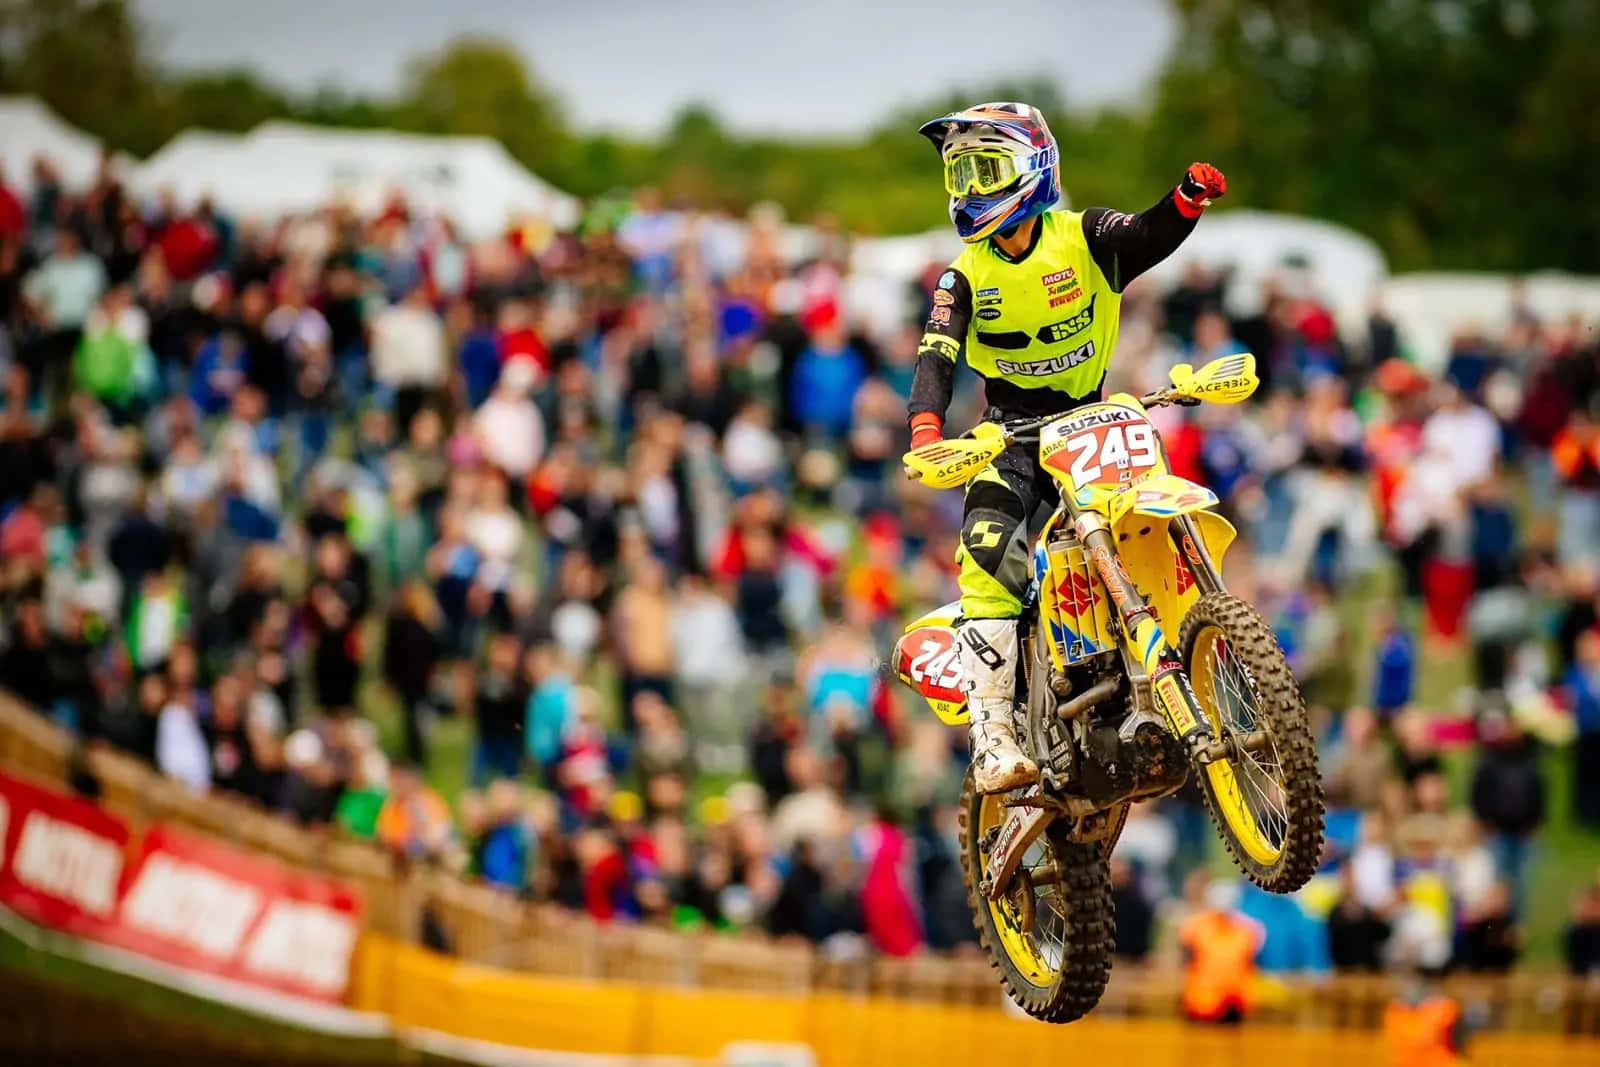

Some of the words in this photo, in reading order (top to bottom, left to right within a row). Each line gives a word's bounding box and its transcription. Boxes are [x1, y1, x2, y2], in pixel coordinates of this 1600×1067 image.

[1044, 269, 1074, 285] MOTU
[996, 341, 1095, 377] SUZUKI
[1057, 411, 1132, 437] SUZUKI
[1041, 440, 1065, 457] ADAC
[1066, 423, 1157, 491] 249
